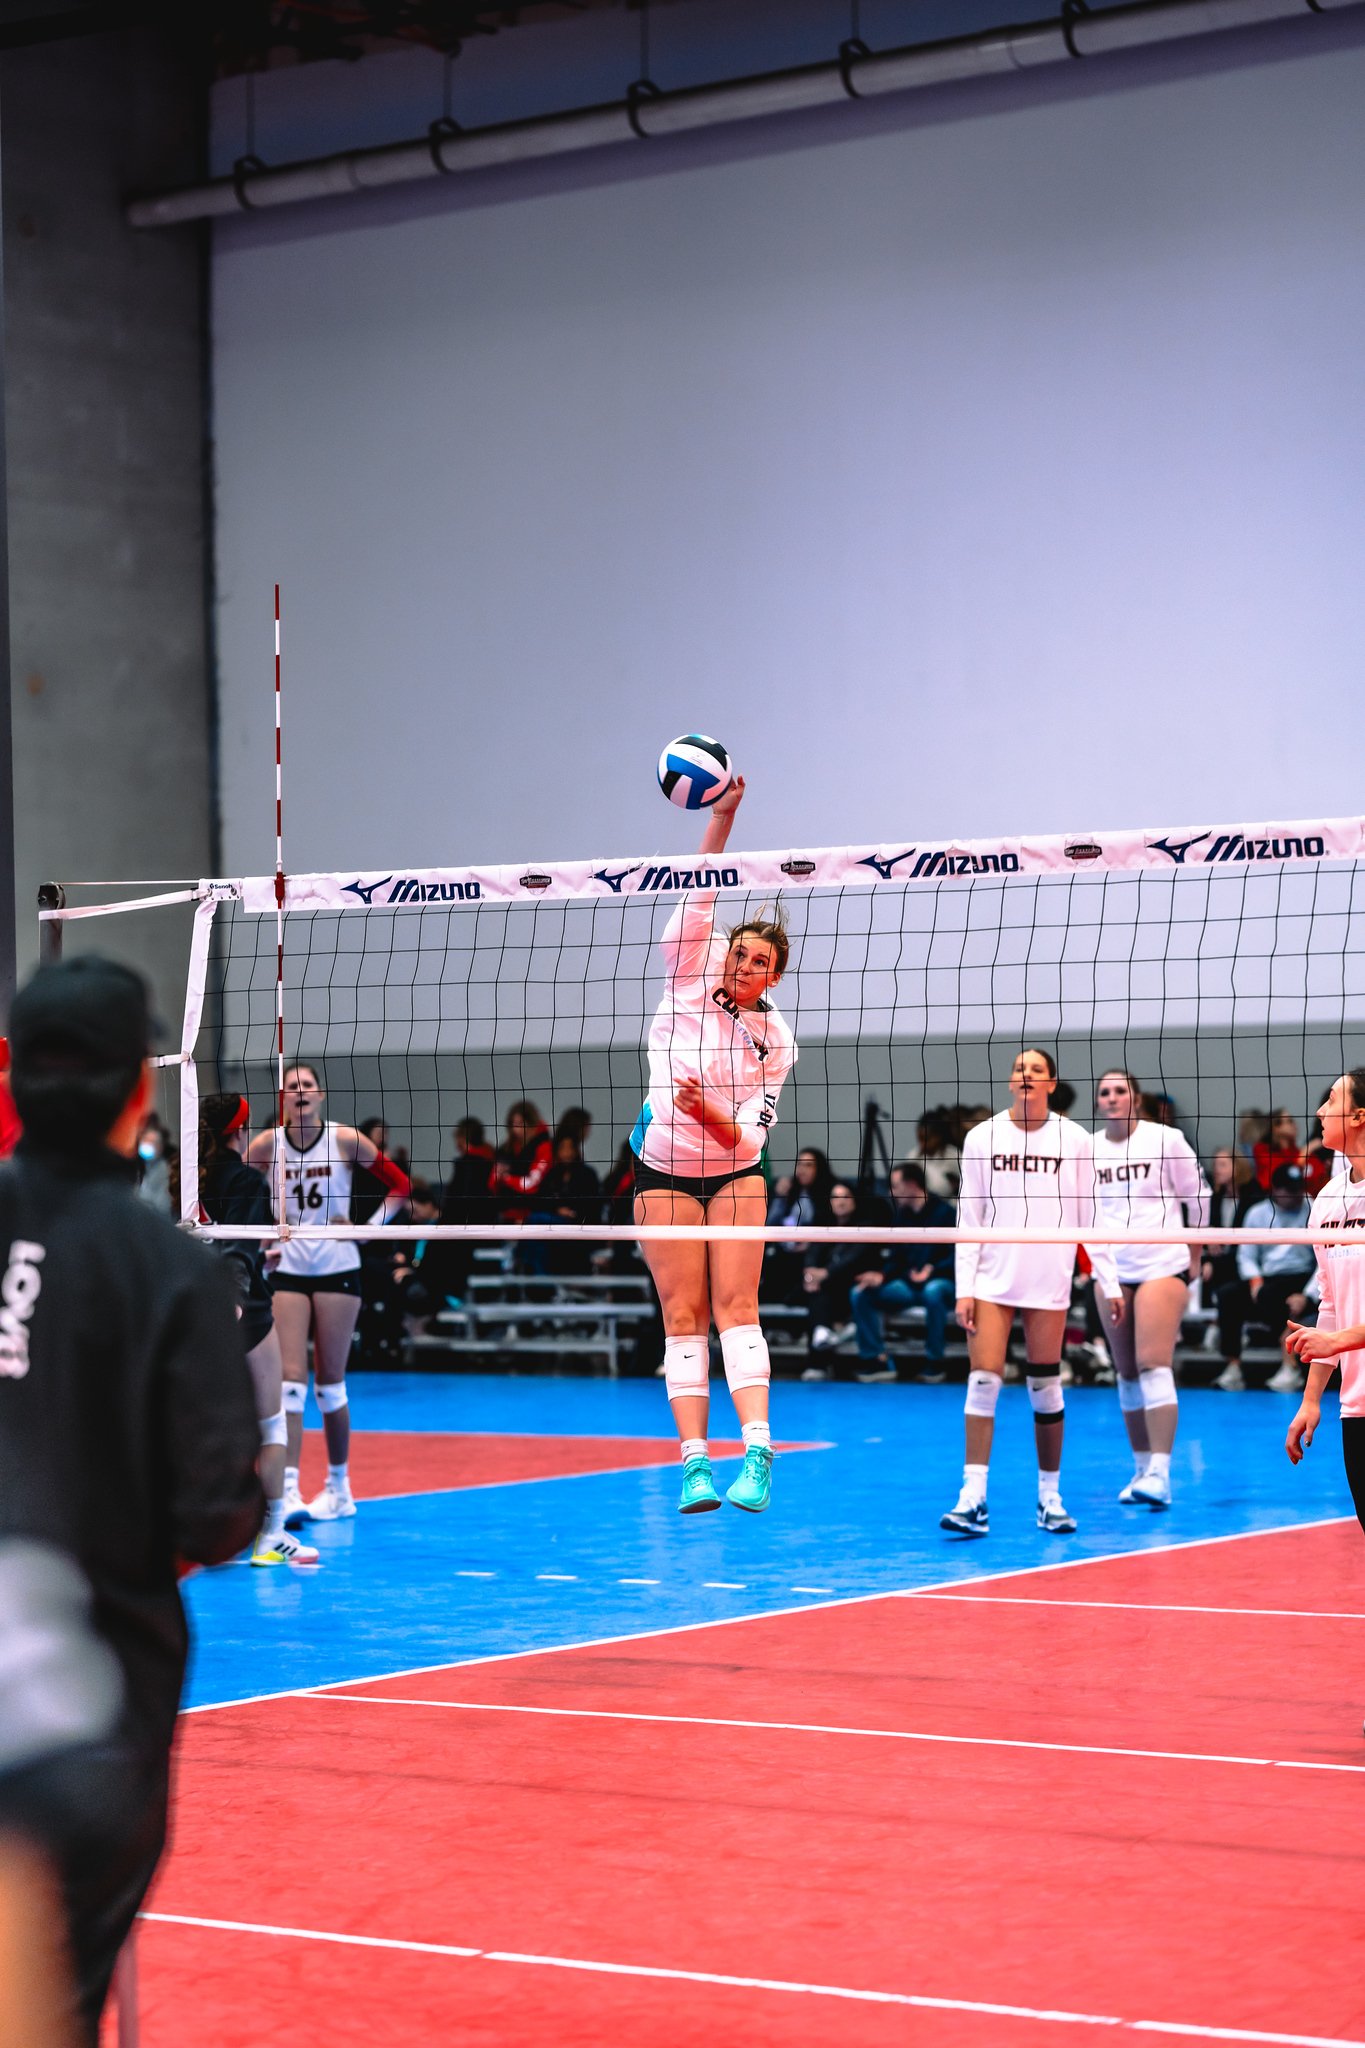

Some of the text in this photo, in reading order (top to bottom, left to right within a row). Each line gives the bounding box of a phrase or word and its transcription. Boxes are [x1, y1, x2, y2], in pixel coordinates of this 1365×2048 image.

[1204, 835, 1324, 862] MIZUNO
[909, 851, 1019, 878] MIZUNO
[387, 879, 480, 903] MIZUNO
[637, 866, 739, 891] MIZUNO
[993, 1154, 1063, 1174] CHI CITY
[1096, 1163, 1151, 1184] HI CITY
[293, 1183, 323, 1210] 16
